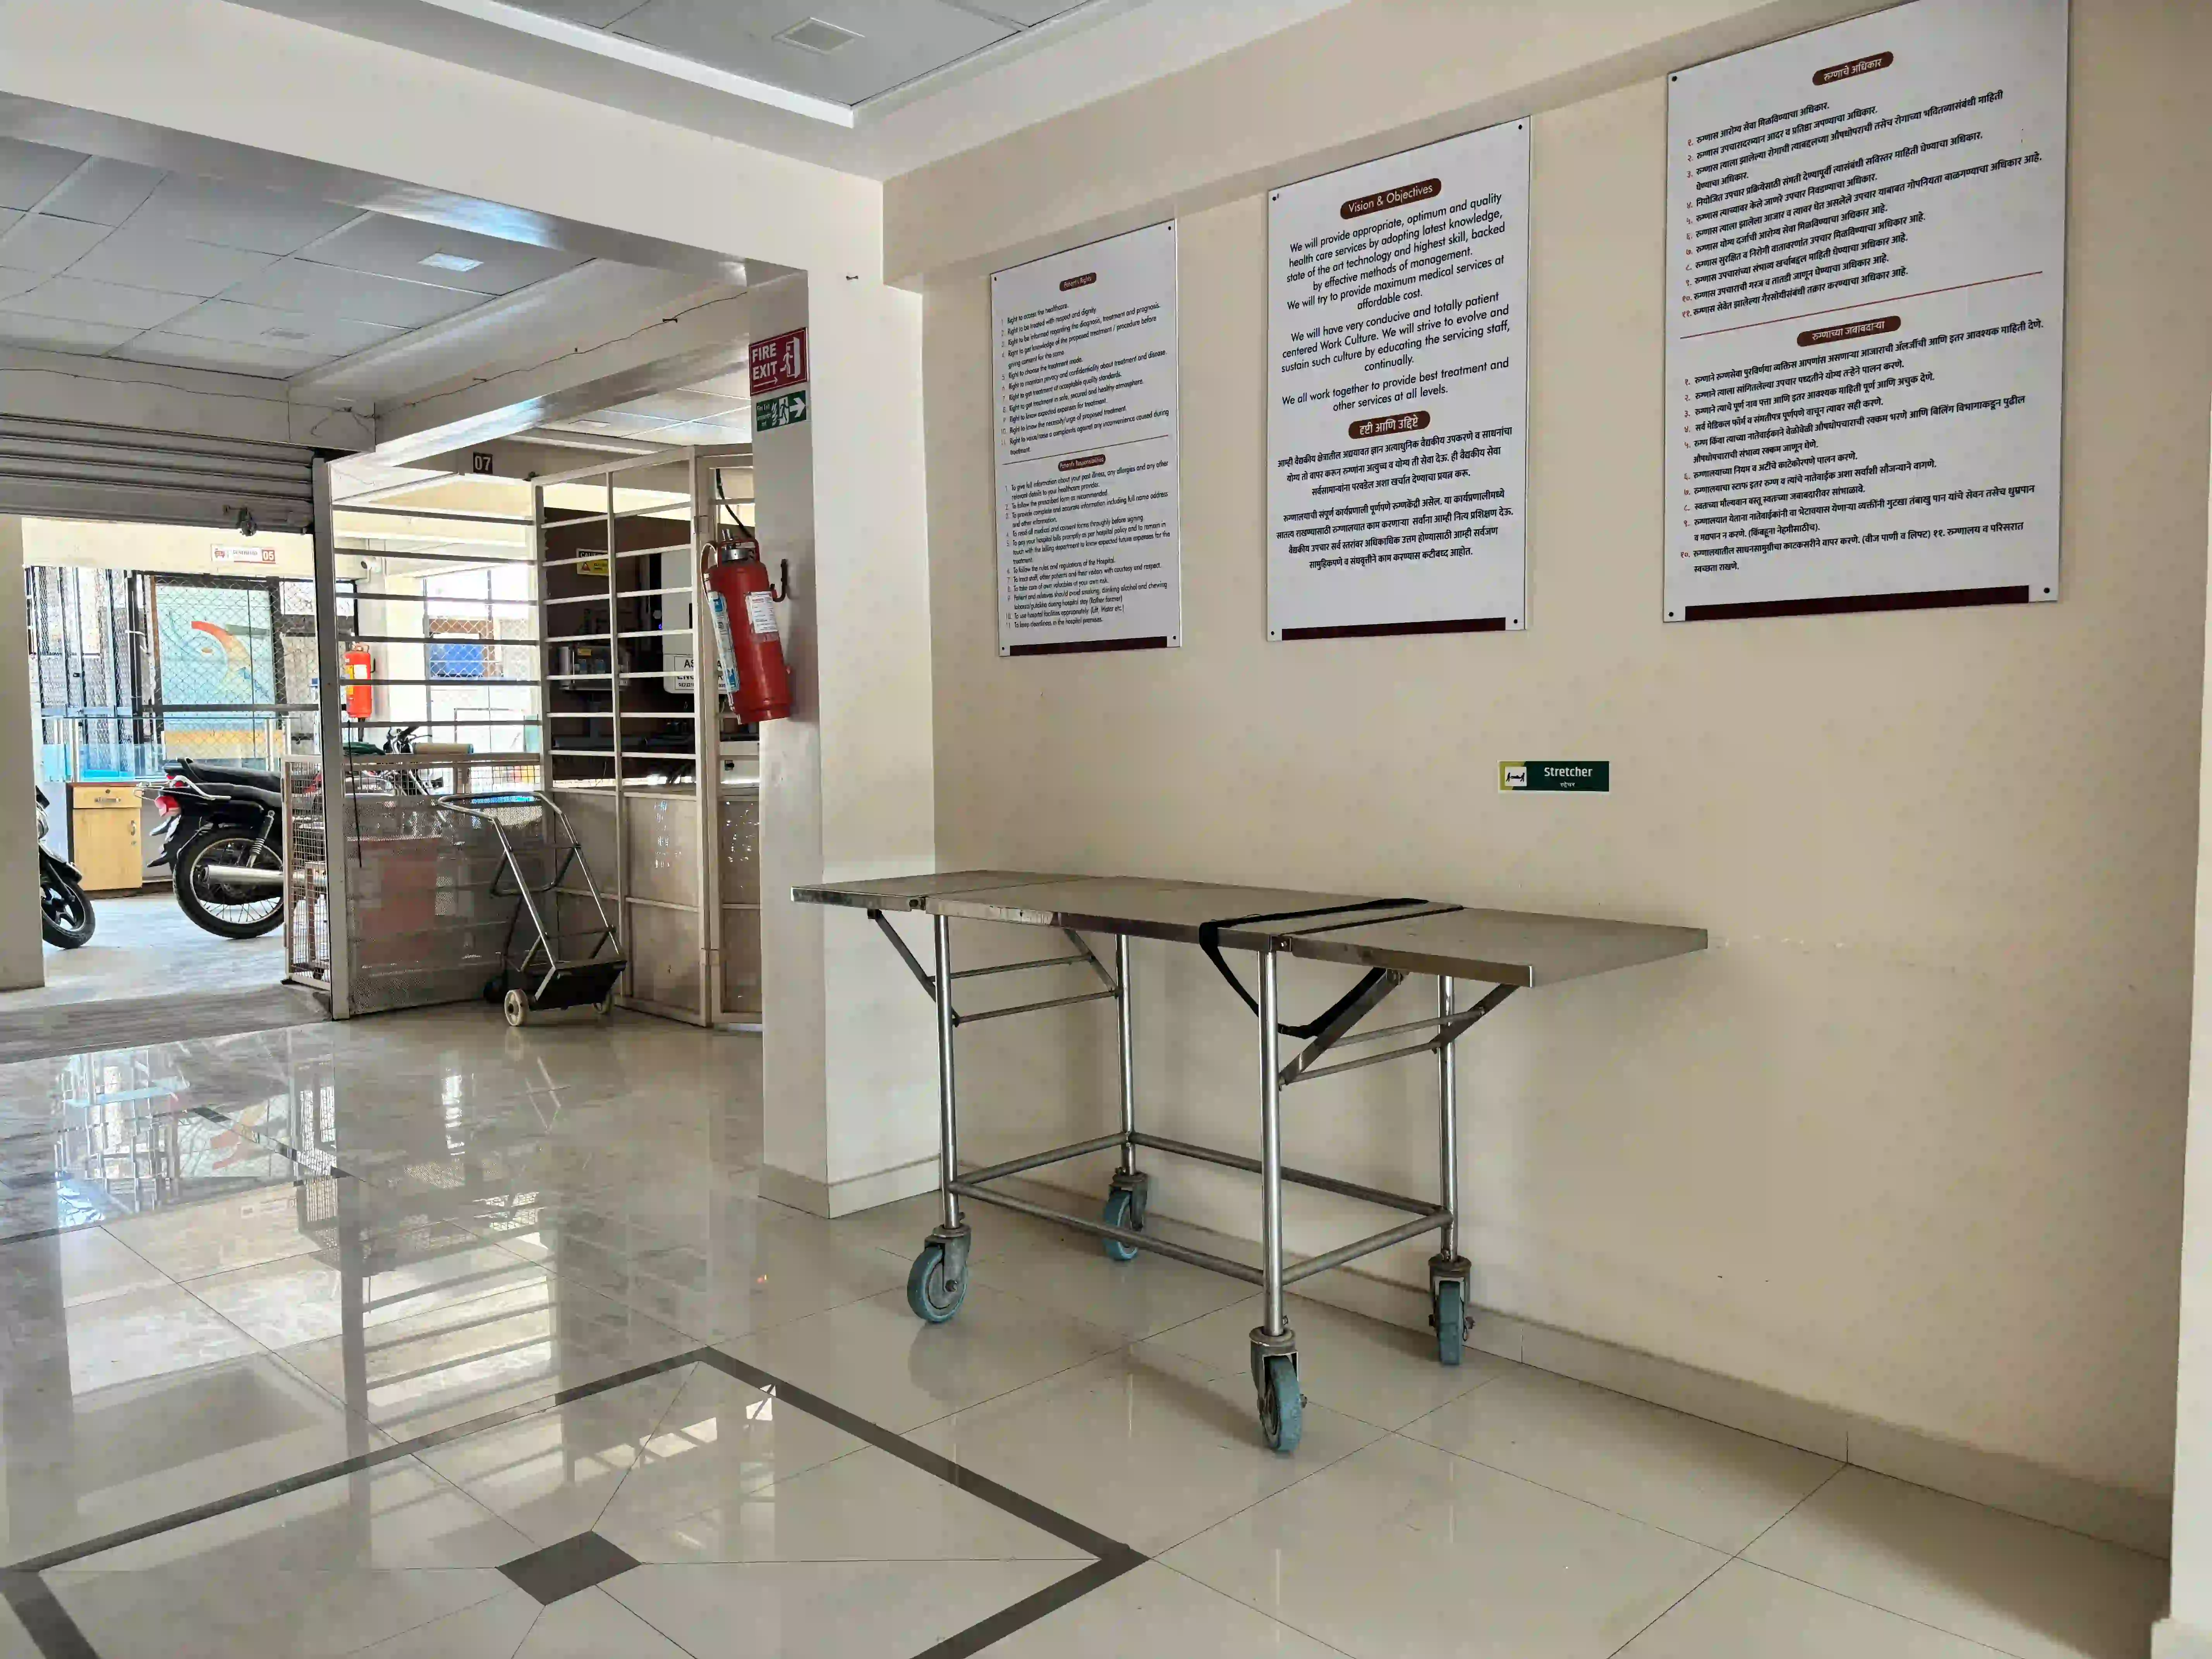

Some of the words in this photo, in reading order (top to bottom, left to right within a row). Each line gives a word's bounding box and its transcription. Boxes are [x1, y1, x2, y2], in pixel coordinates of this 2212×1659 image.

[1348, 200, 1374, 212] Vision
[1377, 196, 1383, 206] &
[1386, 185, 1433, 203] Objectives
[1289, 254, 1313, 268] health
[1316, 251, 1333, 261] care
[1335, 243, 1367, 256] services
[1369, 238, 1379, 250] by
[1381, 229, 1419, 245] adopting
[1423, 221, 1446, 236] latest
[1449, 210, 1503, 230] knowledge,
[1290, 242, 1303, 253] We
[1305, 237, 1317, 249] will
[1321, 230, 1350, 248] provide
[1353, 218, 1404, 239] appropriate,
[1407, 208, 1446, 225] optimum
[1449, 199, 1467, 213] and
[1470, 193, 1502, 210] quality
[1287, 271, 1305, 282] state
[1307, 266, 1316, 277] of
[1317, 264, 1330, 275] the
[1333, 261, 1344, 271] art
[1346, 251, 1392, 268] technology
[1394, 244, 1411, 257] and
[1414, 237, 1446, 253] highest
[1448, 230, 1468, 245] skill,
[1472, 221, 1505, 239] backed
[1313, 281, 1322, 292] by
[1325, 273, 1358, 288] effective
[1360, 263, 1396, 280] methods
[1399, 259, 1408, 271] of
[1410, 247, 1472, 268] management.
[1287, 300, 1300, 310] We
[1302, 295, 1315, 307] will
[1317, 295, 1328, 306] try
[1330, 292, 1338, 301] to
[1340, 283, 1371, 302] provide
[1374, 276, 1416, 292] maximum
[1419, 264, 1453, 282] medical
[1456, 259, 1492, 274] services
[1495, 254, 1504, 265] at
[1357, 292, 1401, 310] affordable
[1403, 289, 1422, 300] cost.
[1282, 342, 1317, 358] centered
[1320, 337, 1342, 350] Work
[1345, 333, 1379, 346] Culture.
[1382, 327, 1396, 338] We
[1399, 323, 1414, 335] will
[1417, 319, 1441, 332] strive
[1444, 317, 1453, 326] to
[1456, 310, 1487, 324] evolve
[1490, 303, 1509, 318] and
[1291, 331, 1304, 342] We
[1306, 327, 1320, 338] will
[1323, 326, 1343, 336] have
[1346, 321, 1364, 331] very
[1366, 311, 1410, 327] conducive
[1413, 304, 1431, 318] and
[1434, 299, 1463, 313] totally
[1465, 292, 1499, 310] patient
[752, 343, 776, 363] FIRE
[1281, 359, 1309, 373] sustain
[1312, 354, 1330, 367] such
[1333, 351, 1362, 362] culture
[1365, 347, 1375, 358] by
[1377, 339, 1422, 354] educating
[1425, 334, 1440, 345] the
[1443, 327, 1484, 342] servicing
[1487, 319, 1510, 334] staff,
[1364, 354, 1414, 371] continually.
[752, 361, 777, 381] EXIT
[1282, 395, 1295, 405] We
[1298, 392, 1307, 403] all
[1310, 388, 1330, 400] work
[1333, 383, 1369, 398] together
[1371, 381, 1380, 391] to
[1383, 374, 1416, 391] provide
[1419, 371, 1438, 382] best
[1441, 362, 1487, 378] treatment
[1490, 356, 1509, 370] and
[1333, 400, 1356, 411] other
[1358, 395, 1392, 407] services
[1395, 392, 1403, 401] at
[1406, 388, 1417, 399] all
[1420, 384, 1448, 397] levels.
[475, 455, 491, 471] 07
[263, 551, 274, 560] 05
[1544, 766, 1593, 777] Stretcher
